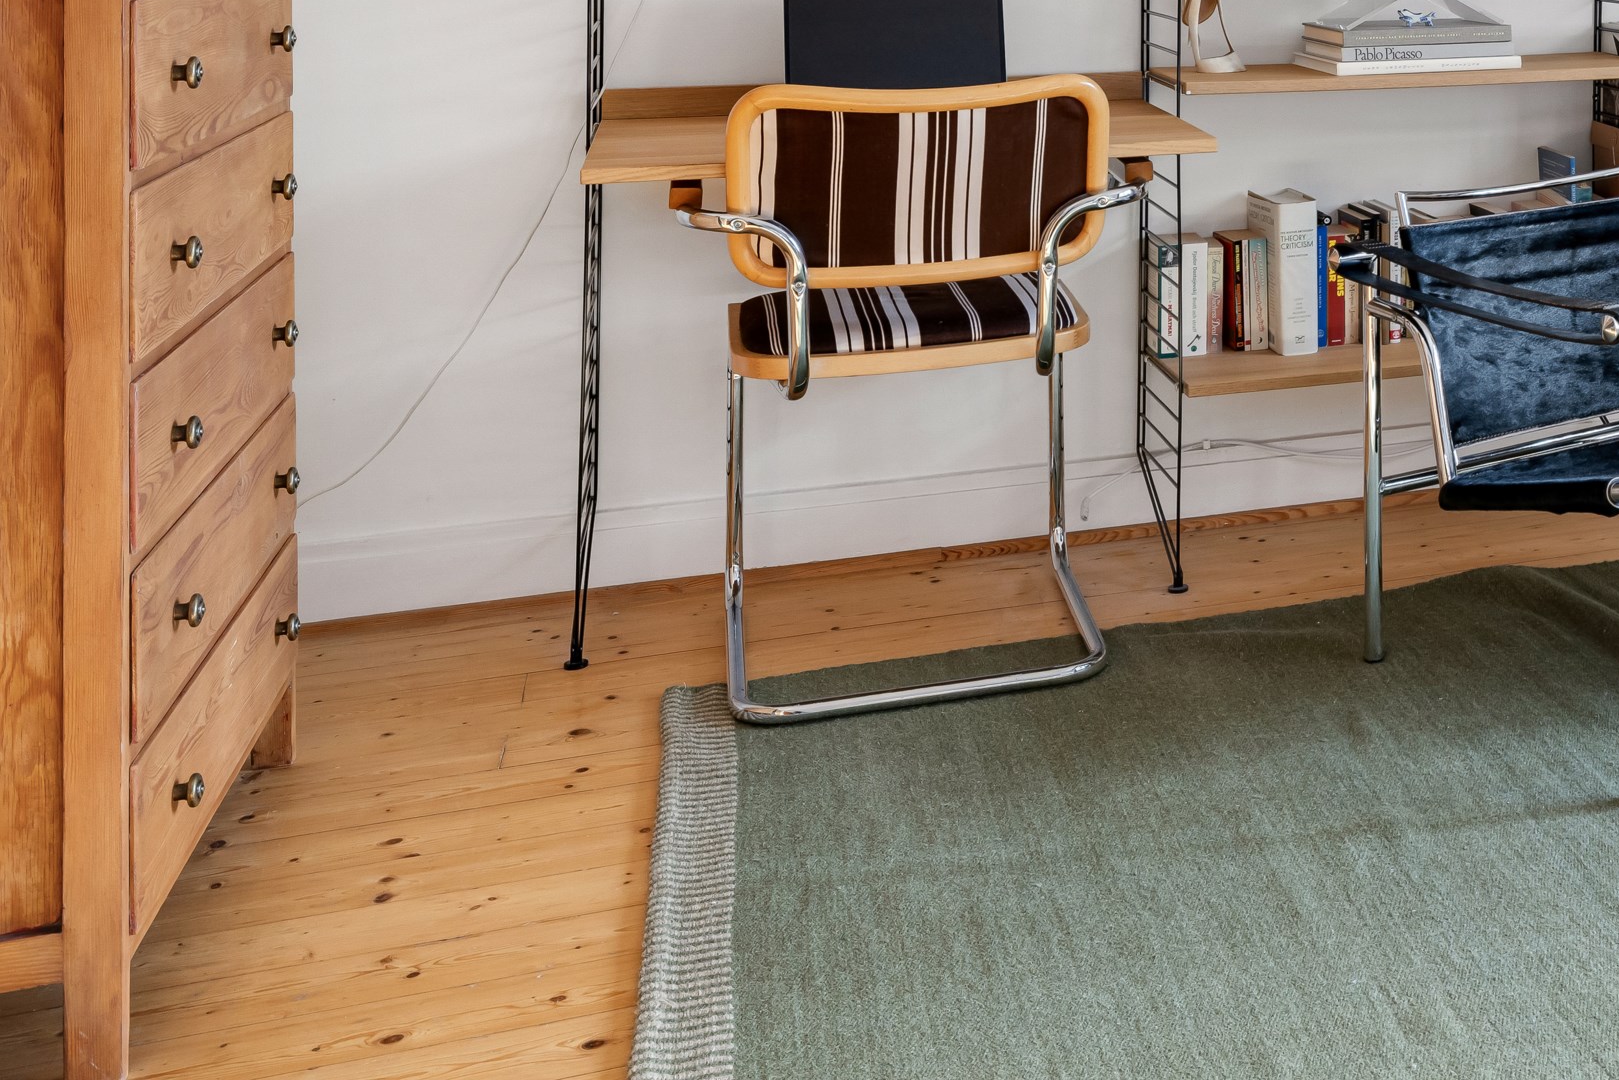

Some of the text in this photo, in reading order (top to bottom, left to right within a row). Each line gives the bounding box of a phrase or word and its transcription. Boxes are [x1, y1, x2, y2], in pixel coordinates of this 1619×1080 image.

[1355, 47, 1422, 61] Pablo Picasso
[1281, 234, 1306, 243] THEORY
[1281, 240, 1314, 251] CRITICISM
